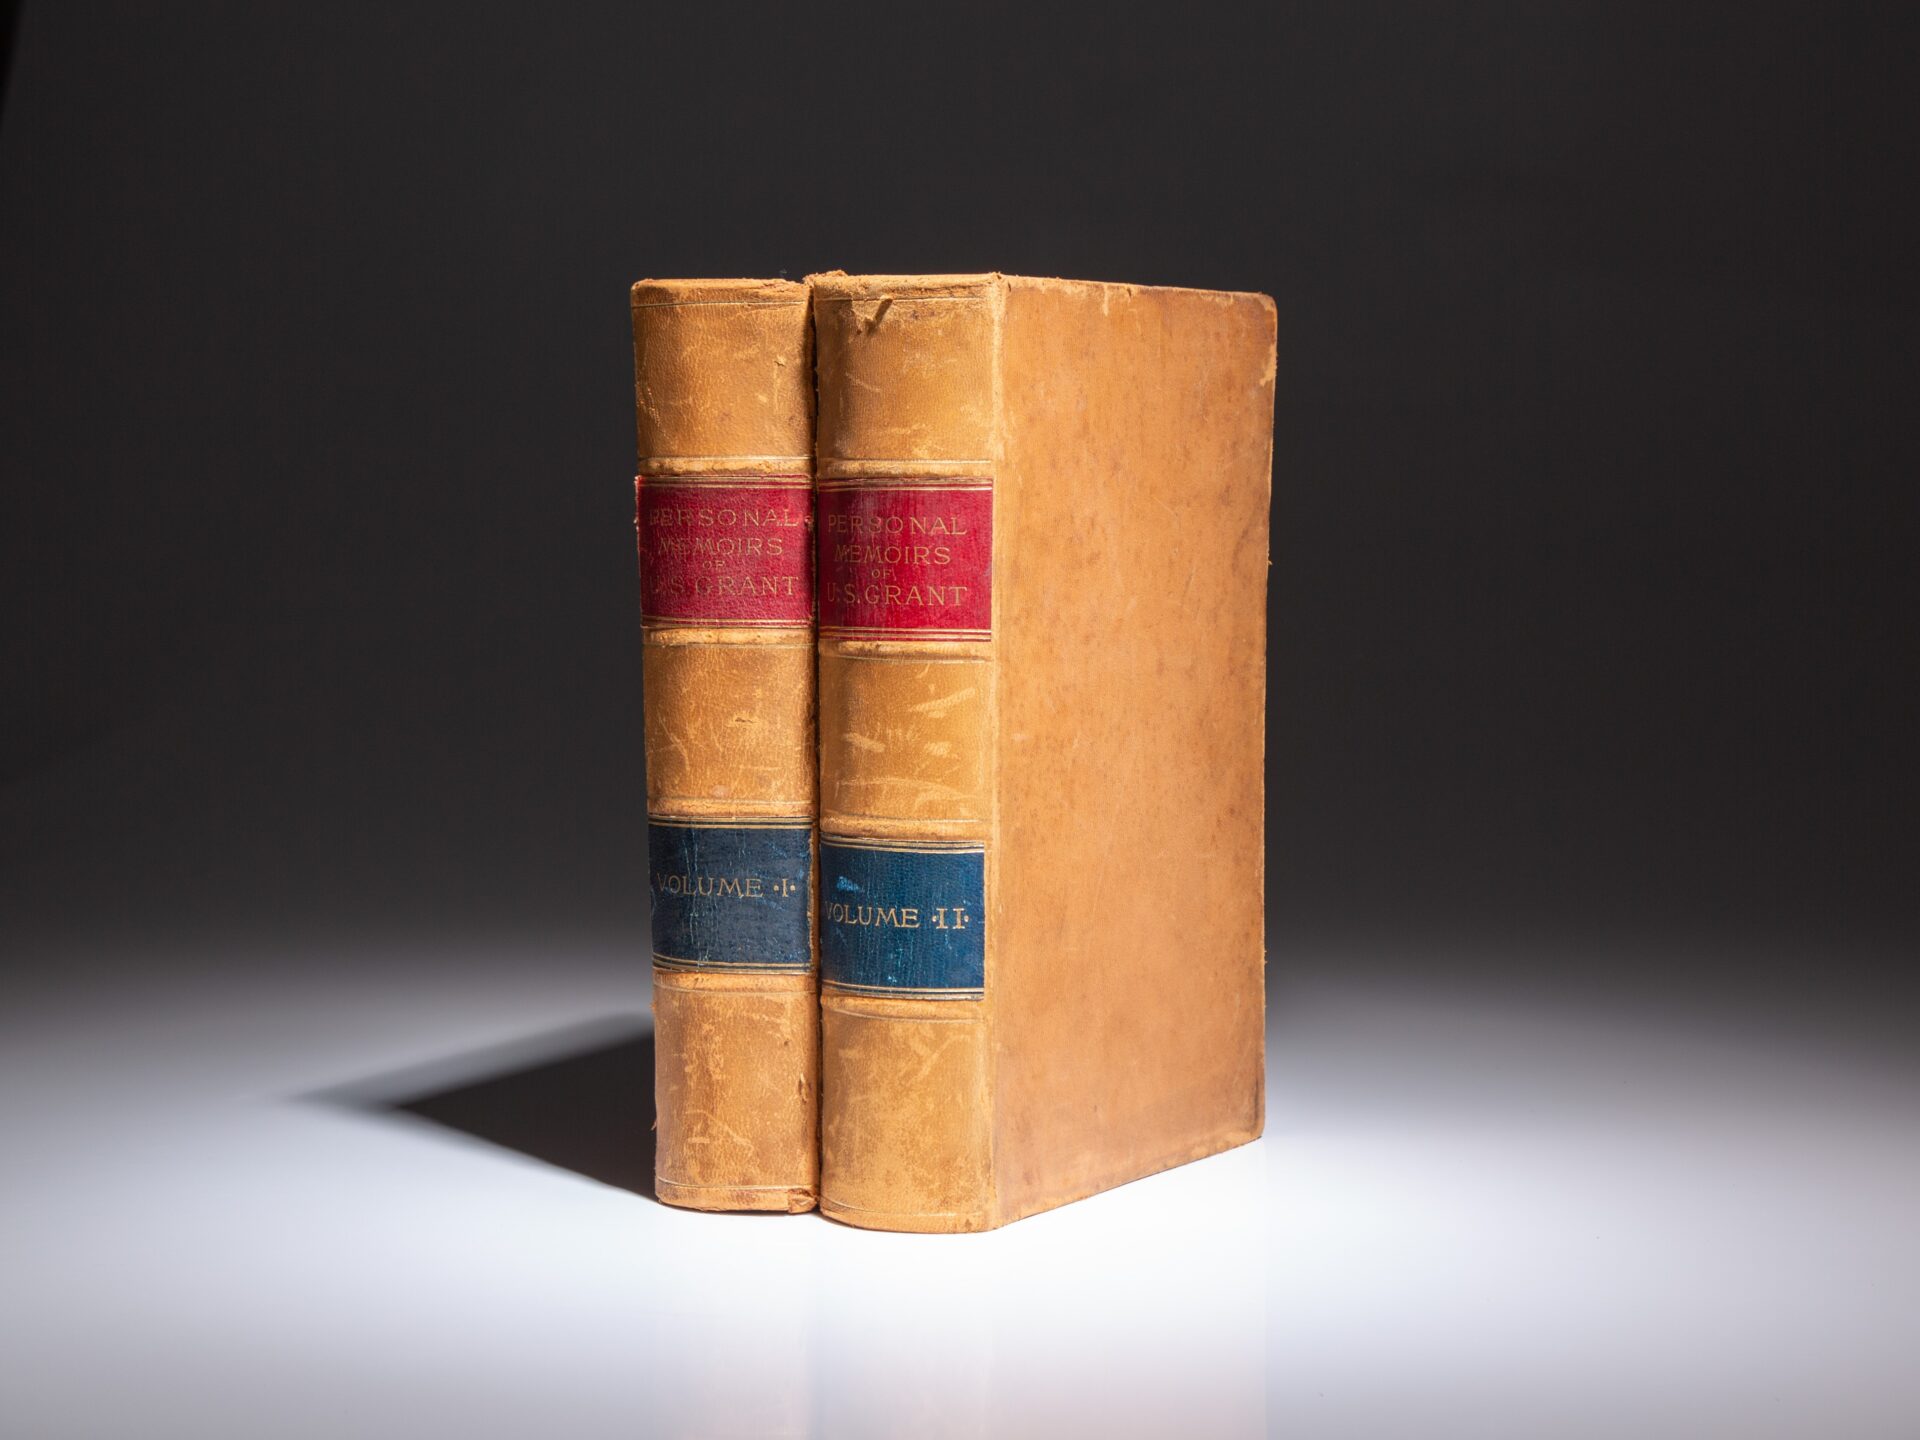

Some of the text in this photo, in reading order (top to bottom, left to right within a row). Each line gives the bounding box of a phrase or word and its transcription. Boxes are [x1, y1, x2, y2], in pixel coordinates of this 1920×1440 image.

[828, 514, 968, 535] PERSONAL
[702, 560, 726, 570] OF
[834, 544, 952, 565] MEMOIRS
[871, 568, 893, 579] OF
[657, 872, 764, 898] VOLUME
[825, 901, 920, 929] VOLUME
